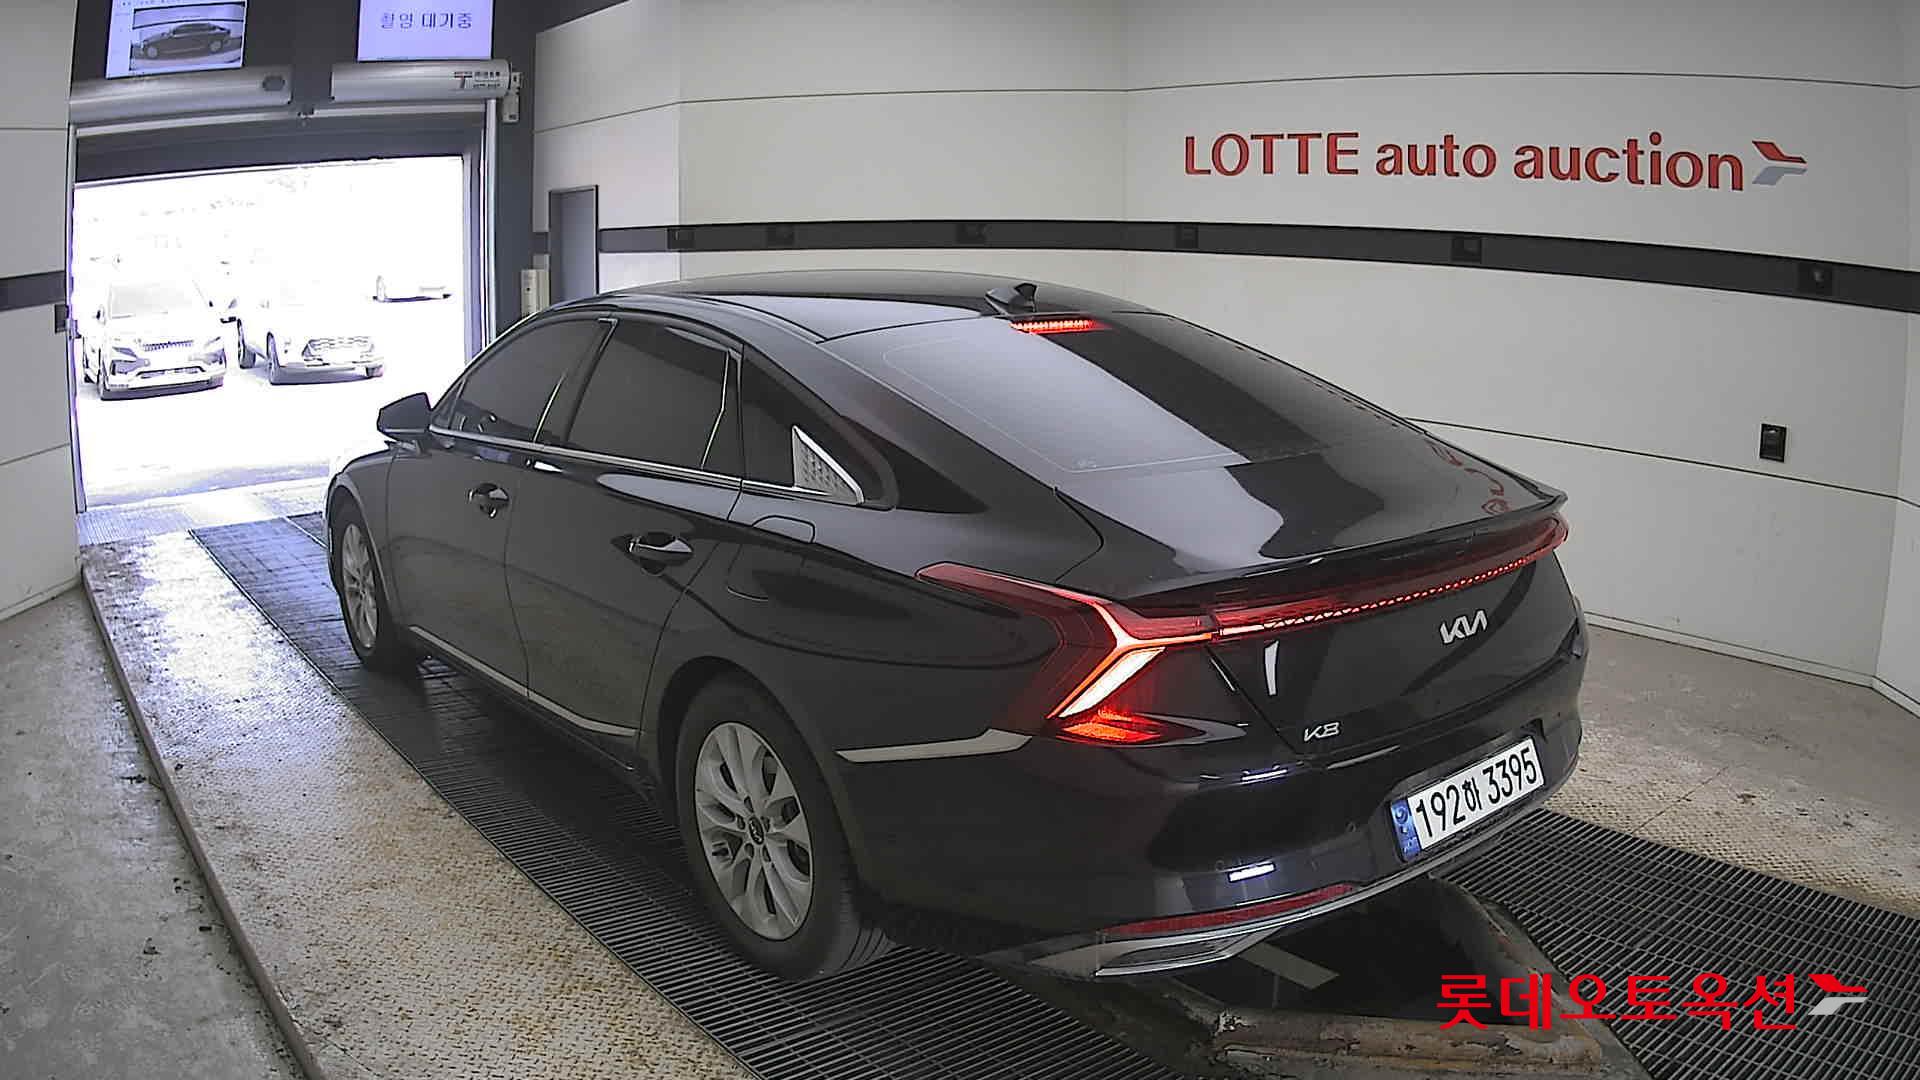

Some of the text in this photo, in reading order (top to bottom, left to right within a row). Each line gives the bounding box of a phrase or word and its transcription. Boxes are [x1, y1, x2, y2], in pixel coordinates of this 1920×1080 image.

[421, 12, 473, 29] 대기중
[1184, 132, 1744, 191] LOTTE auto auction
[1303, 722, 1340, 742] K8
[1415, 747, 1537, 837] 192하 3395
